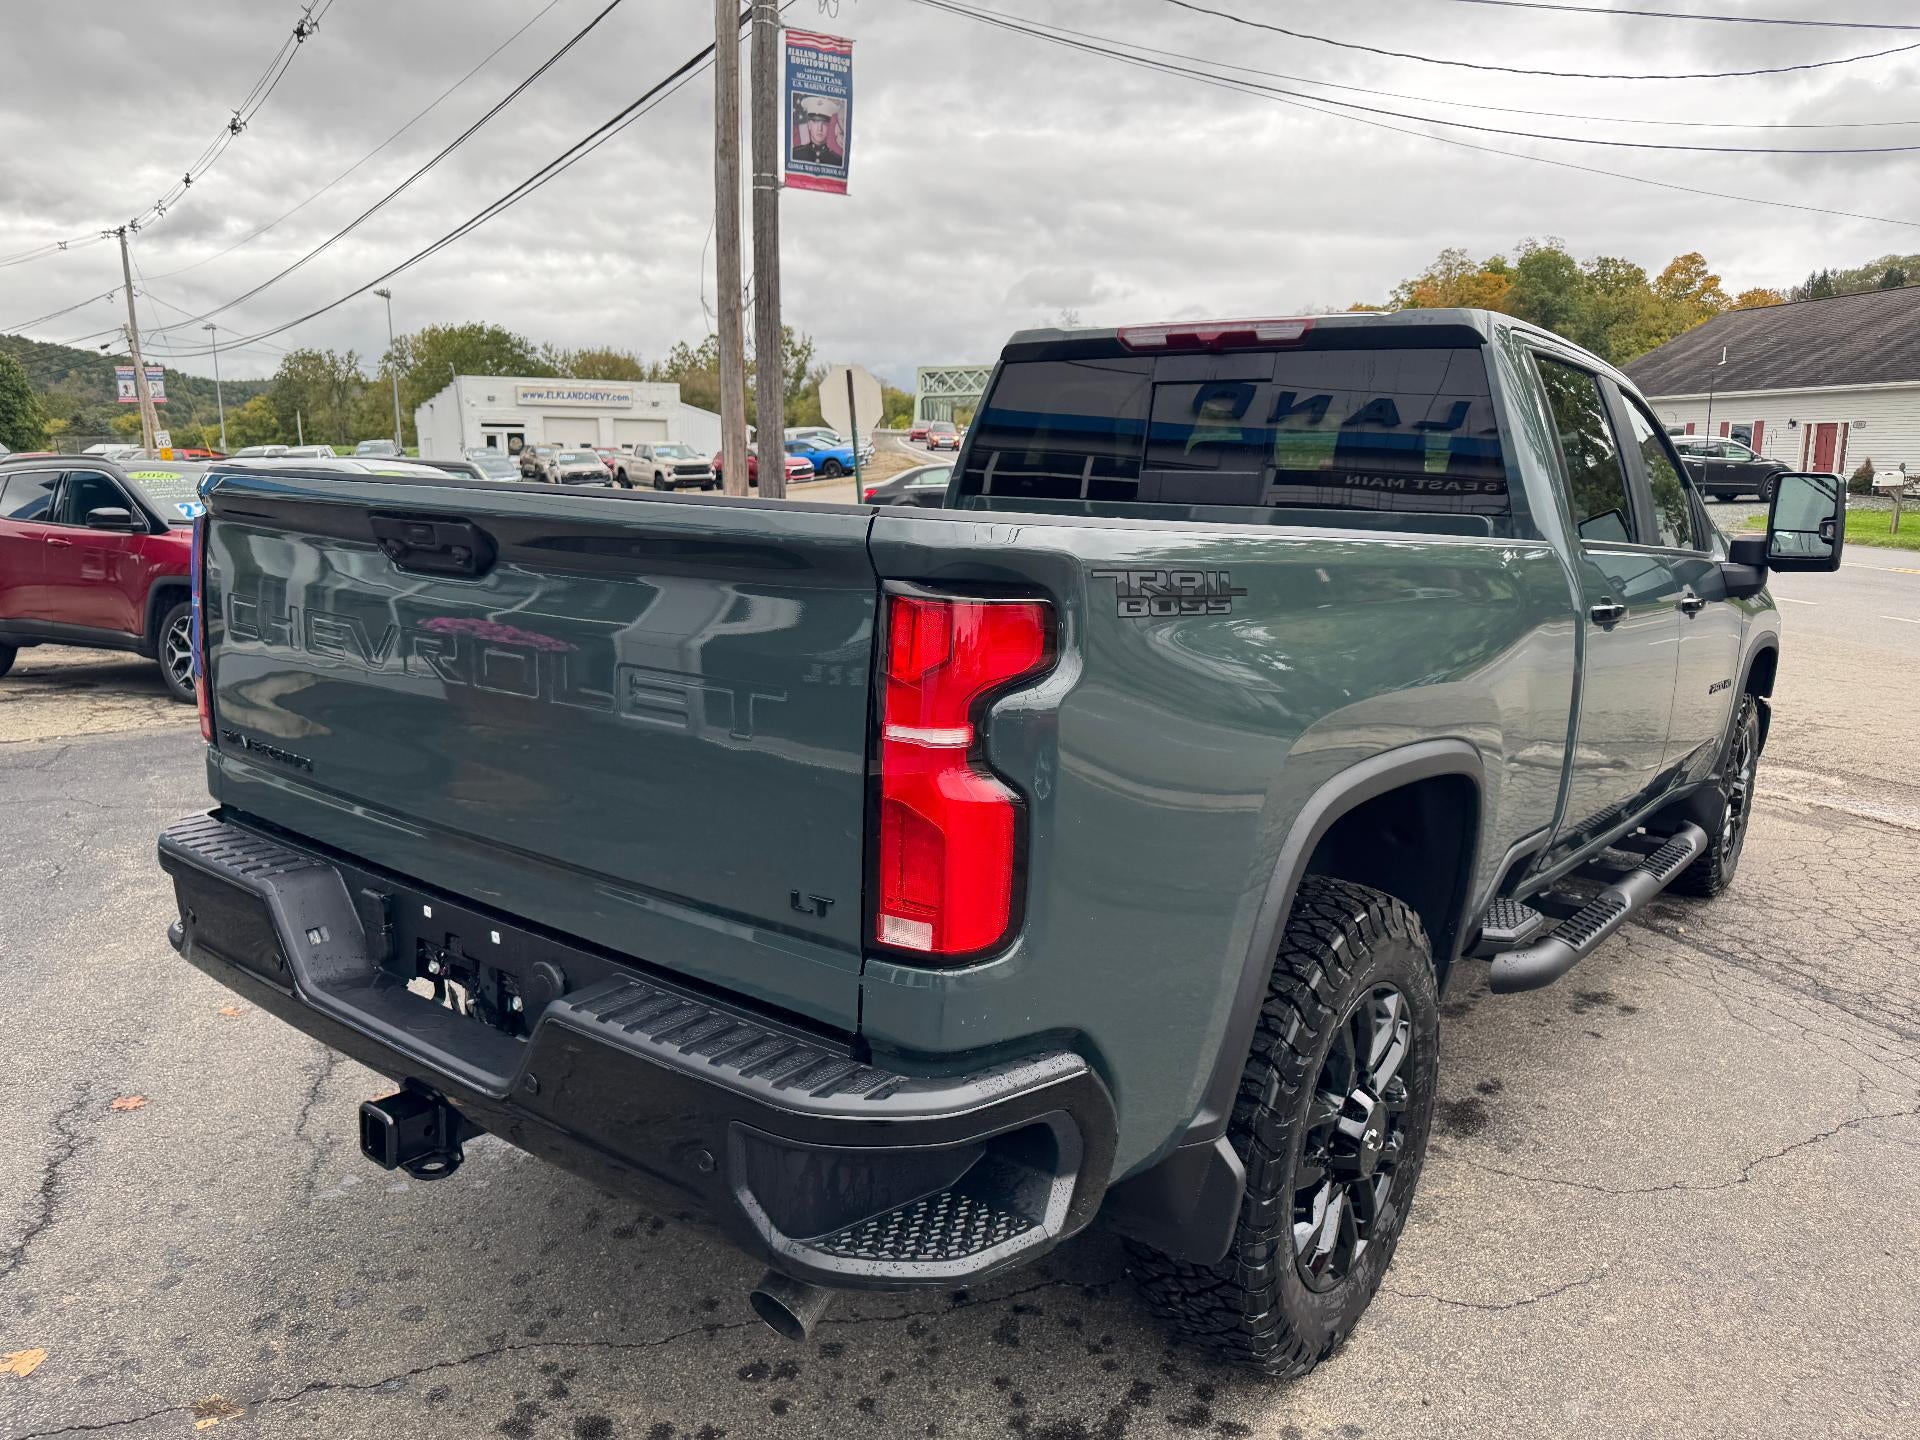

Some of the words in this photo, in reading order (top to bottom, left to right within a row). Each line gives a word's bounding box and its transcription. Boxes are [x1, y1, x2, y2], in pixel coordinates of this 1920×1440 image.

[788, 47, 817, 60] ELKLAND
[790, 55, 829, 70] HOMETOWN
[830, 62, 848, 73] HERO
[796, 72, 823, 82] MICHAEL
[803, 82, 827, 91] MARINE
[522, 390, 630, 401] www.ELKLANDCHEVY.com
[158, 439, 171, 447] 40
[1091, 569, 1248, 597] TRAIL
[1117, 595, 1232, 618] BOSS
[227, 592, 788, 741] CHEVROLET
[790, 889, 835, 919] LT
